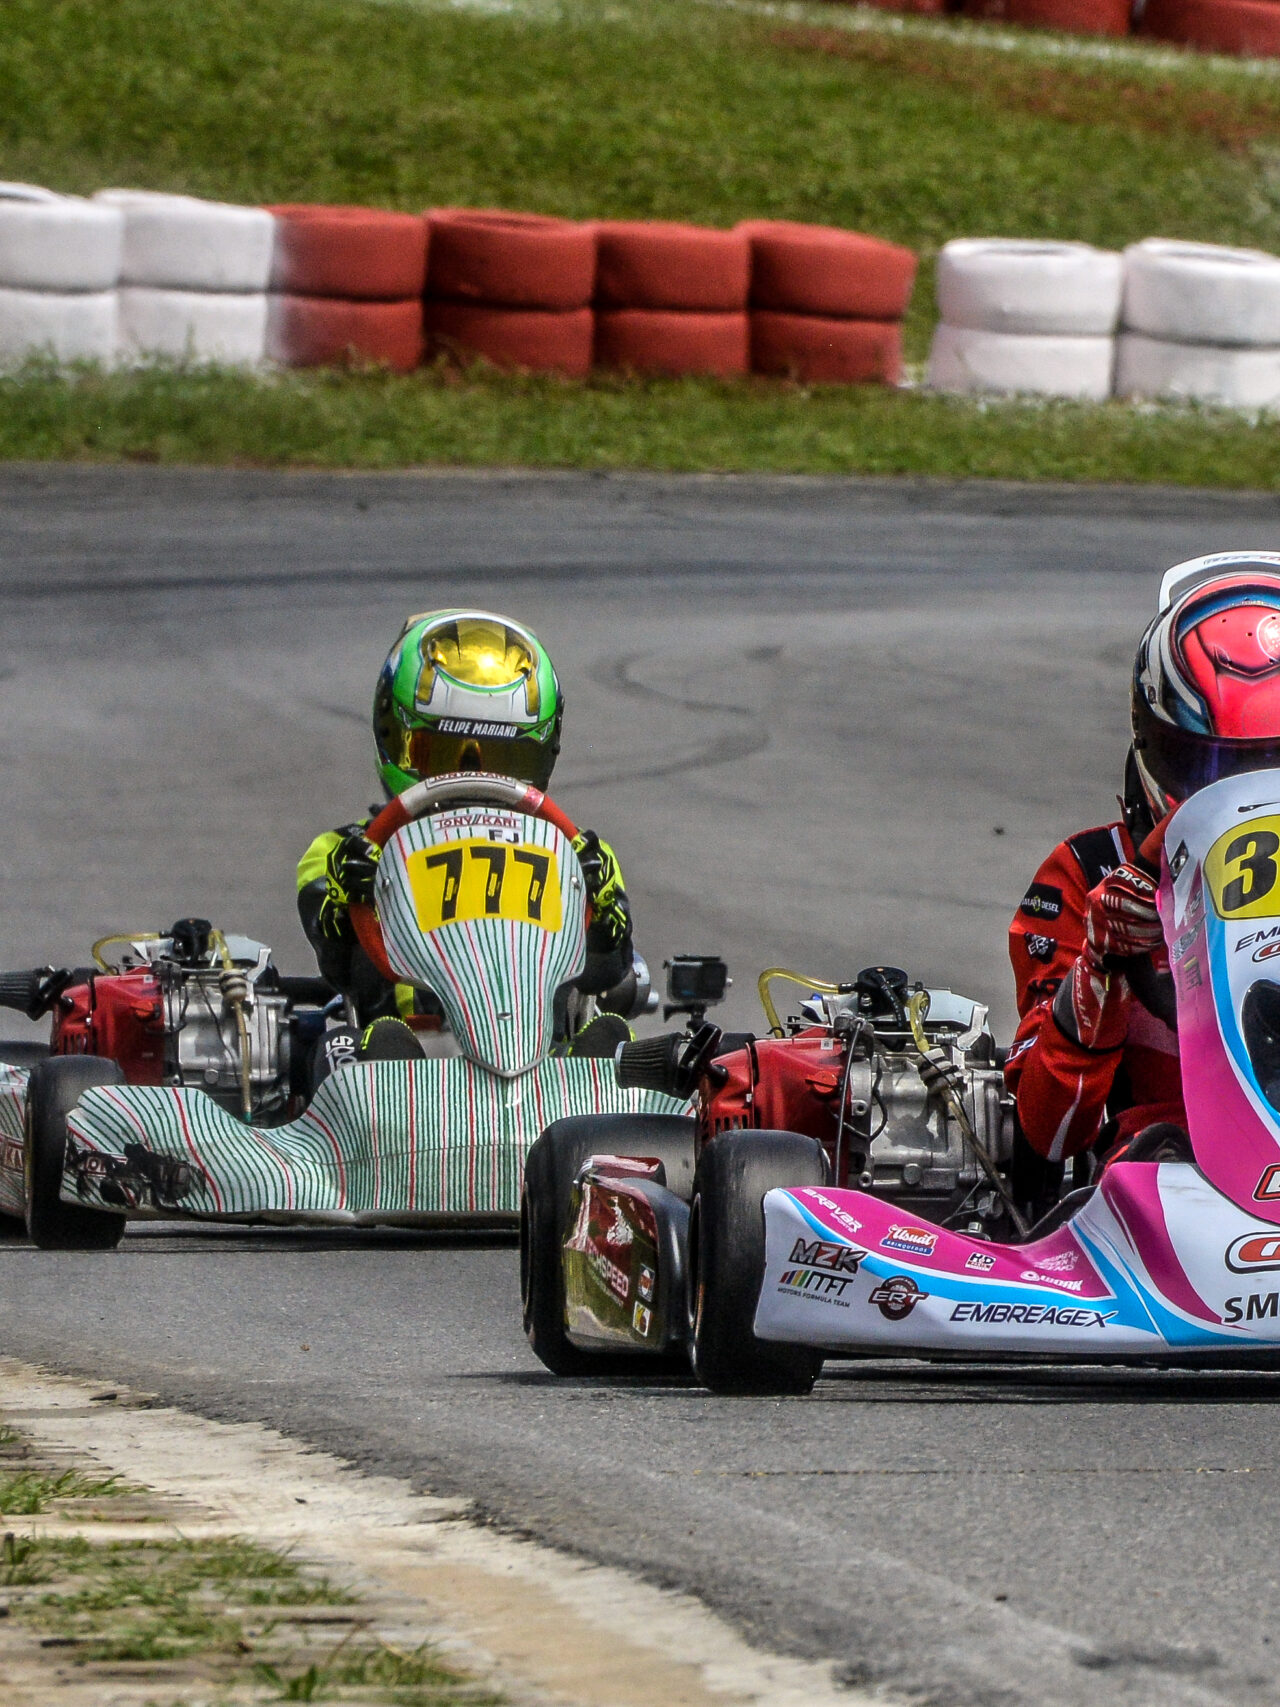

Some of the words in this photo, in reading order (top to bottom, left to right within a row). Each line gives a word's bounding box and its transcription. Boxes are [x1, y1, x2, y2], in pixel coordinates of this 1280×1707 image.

[438, 719, 472, 734] FELIPE
[472, 722, 518, 738] MARIANO
[489, 829, 520, 844] FJ
[425, 846, 550, 922] 777
[788, 1238, 868, 1275] MZK
[777, 1287, 802, 1297] MOTORS
[802, 1292, 832, 1304] FORMULA
[833, 1299, 851, 1308] TEAM
[872, 1291, 926, 1303] ERT
[949, 1303, 1117, 1328] EMBREAGEX
